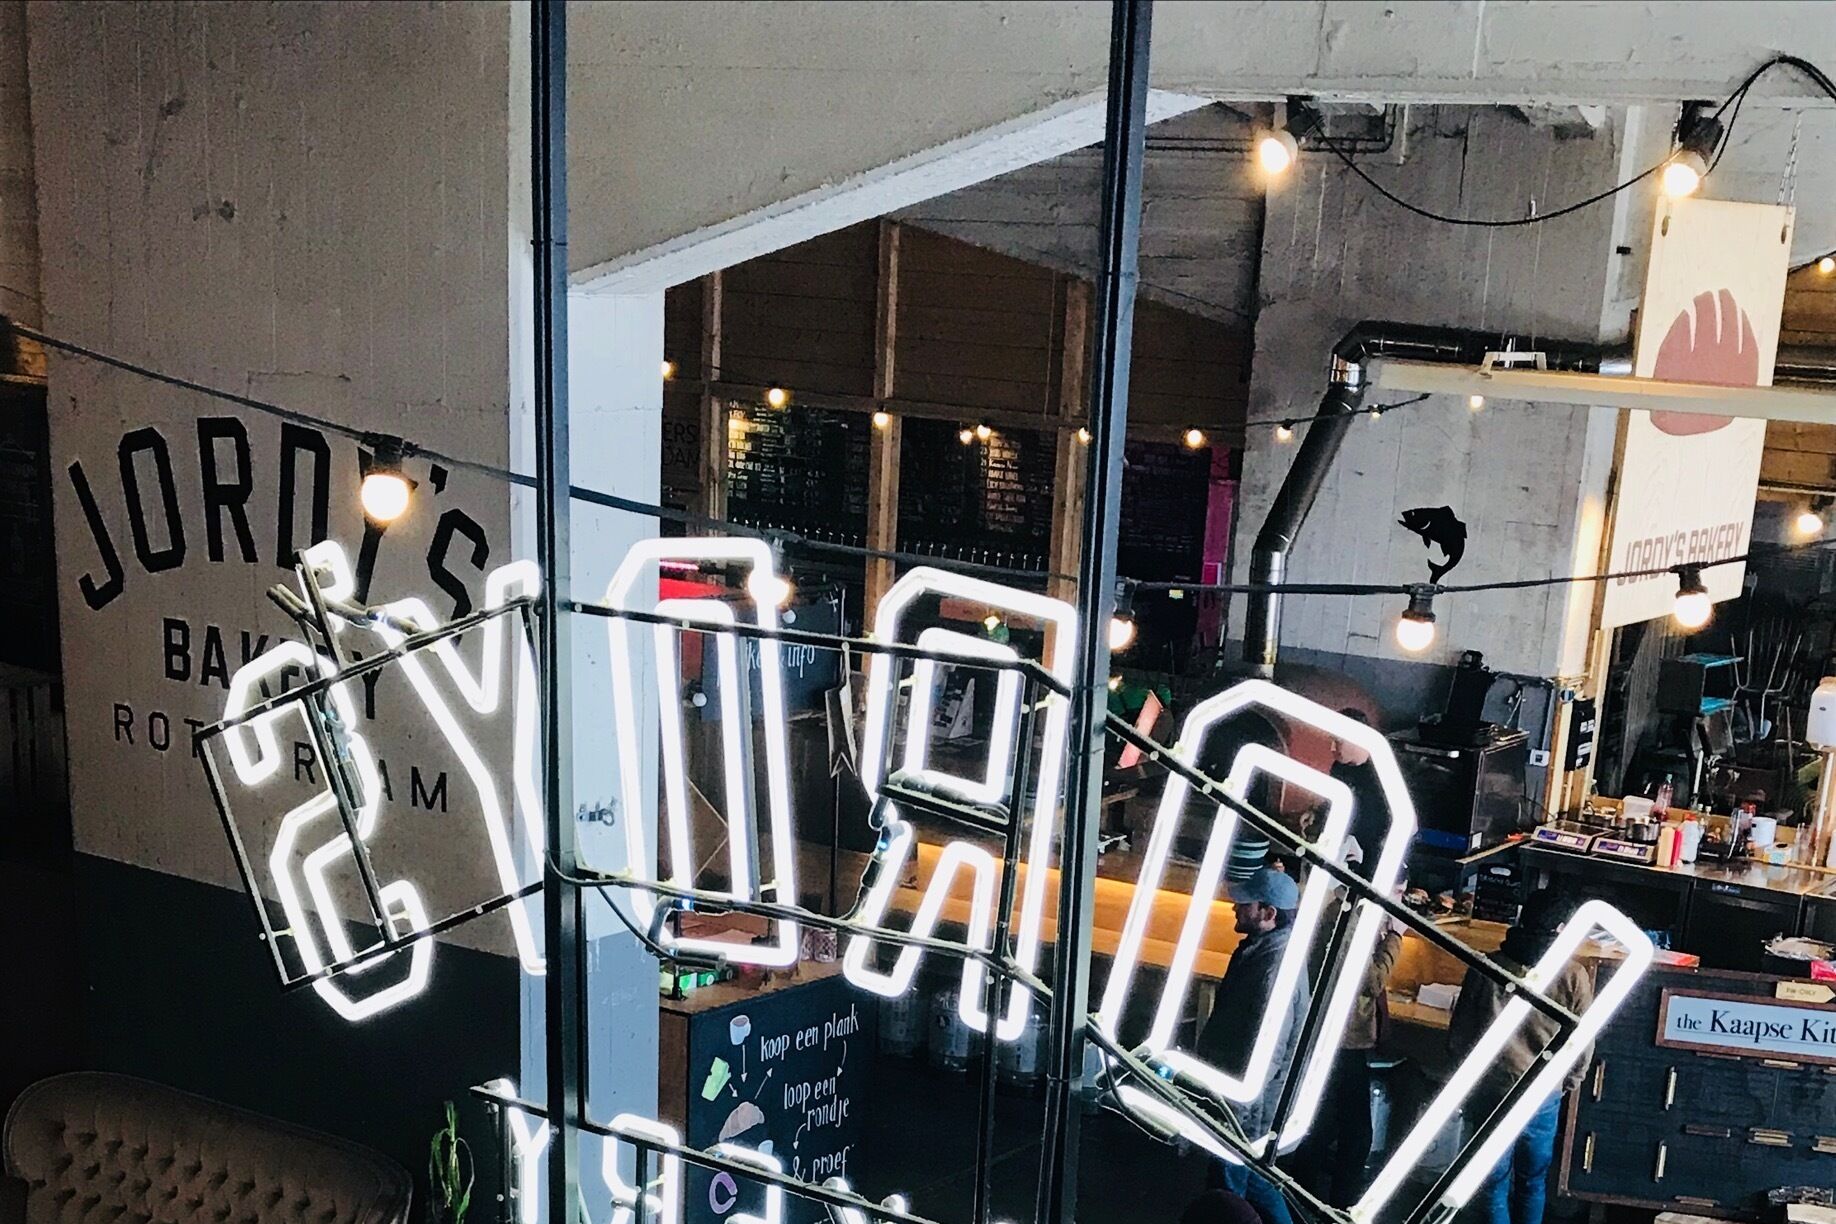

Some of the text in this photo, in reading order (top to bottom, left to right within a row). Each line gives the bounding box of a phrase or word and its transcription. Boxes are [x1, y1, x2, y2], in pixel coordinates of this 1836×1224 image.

[1616, 521, 1744, 586] JORDY'S BAKERY
[760, 1003, 859, 1063] koop een plank
[1677, 1013, 1702, 1031] the
[1710, 1009, 1793, 1044] Kaapse
[784, 1076, 836, 1113] loop een
[807, 1094, 850, 1131] rondje
